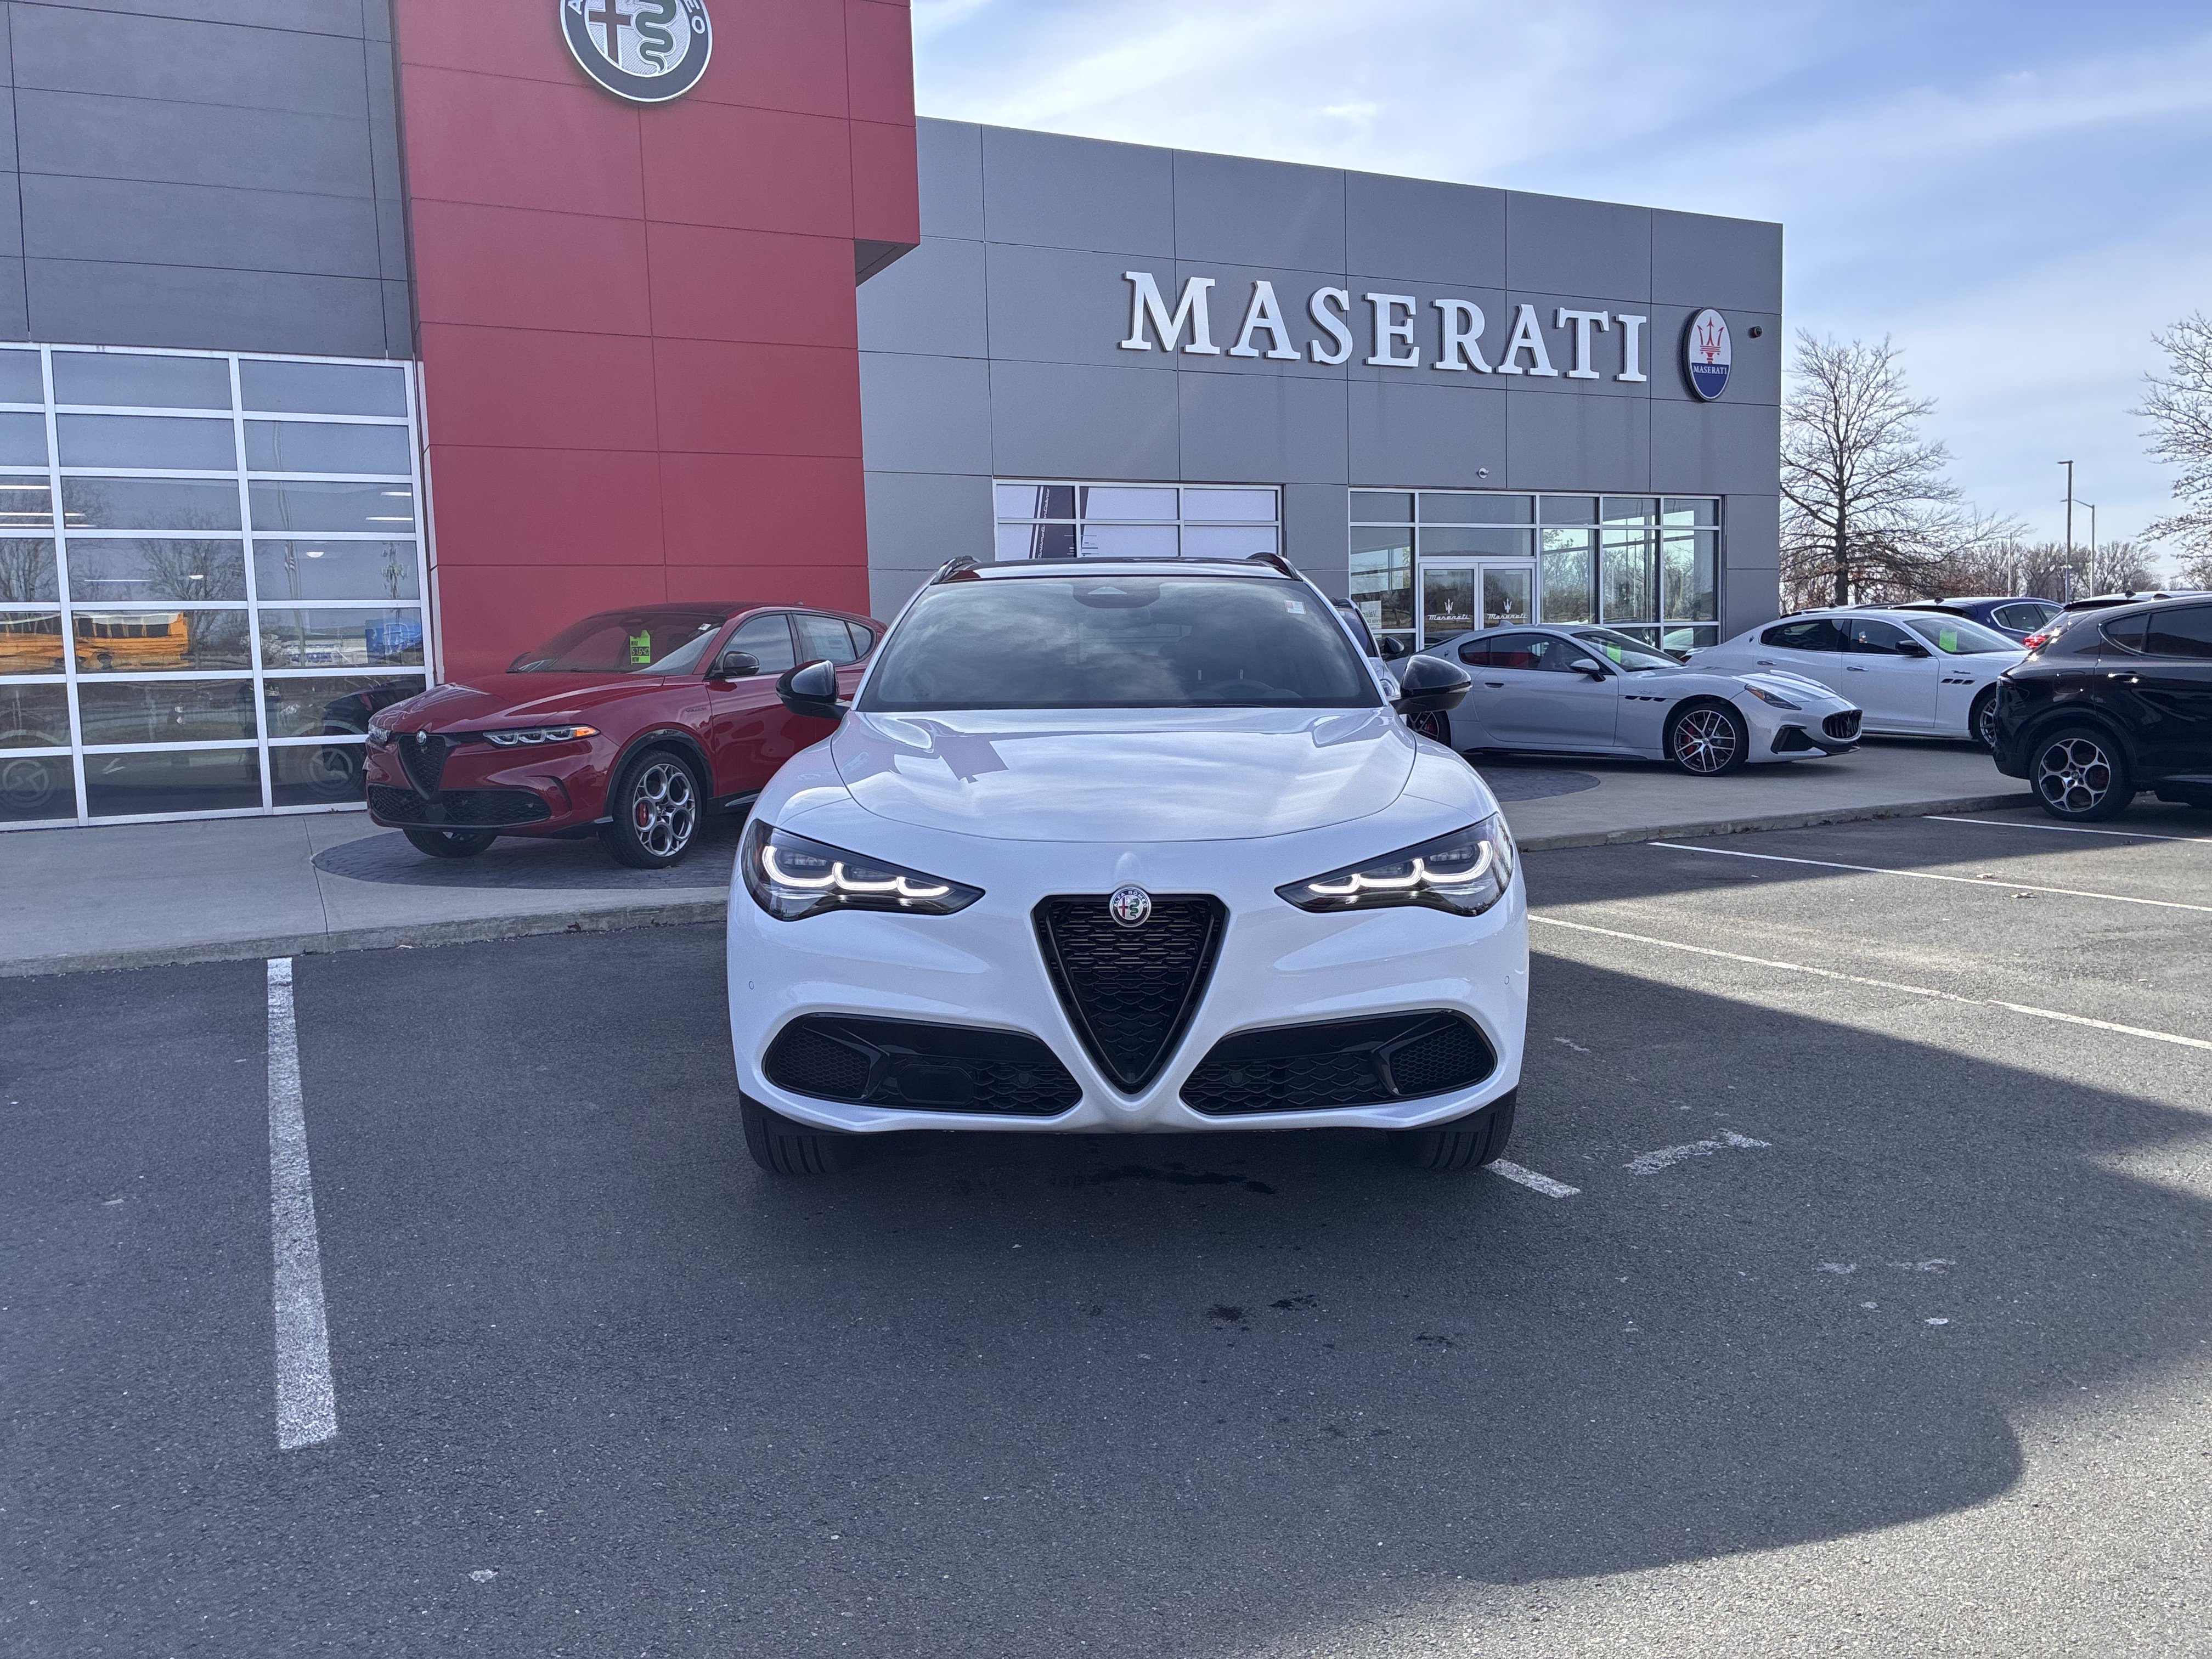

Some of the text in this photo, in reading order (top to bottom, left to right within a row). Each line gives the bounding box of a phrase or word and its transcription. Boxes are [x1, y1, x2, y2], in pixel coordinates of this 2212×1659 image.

[1119, 270, 1647, 383] MASERATI
[1693, 365, 1727, 375] MASERATI
[1113, 890, 1147, 908] ALFA ROMEO
